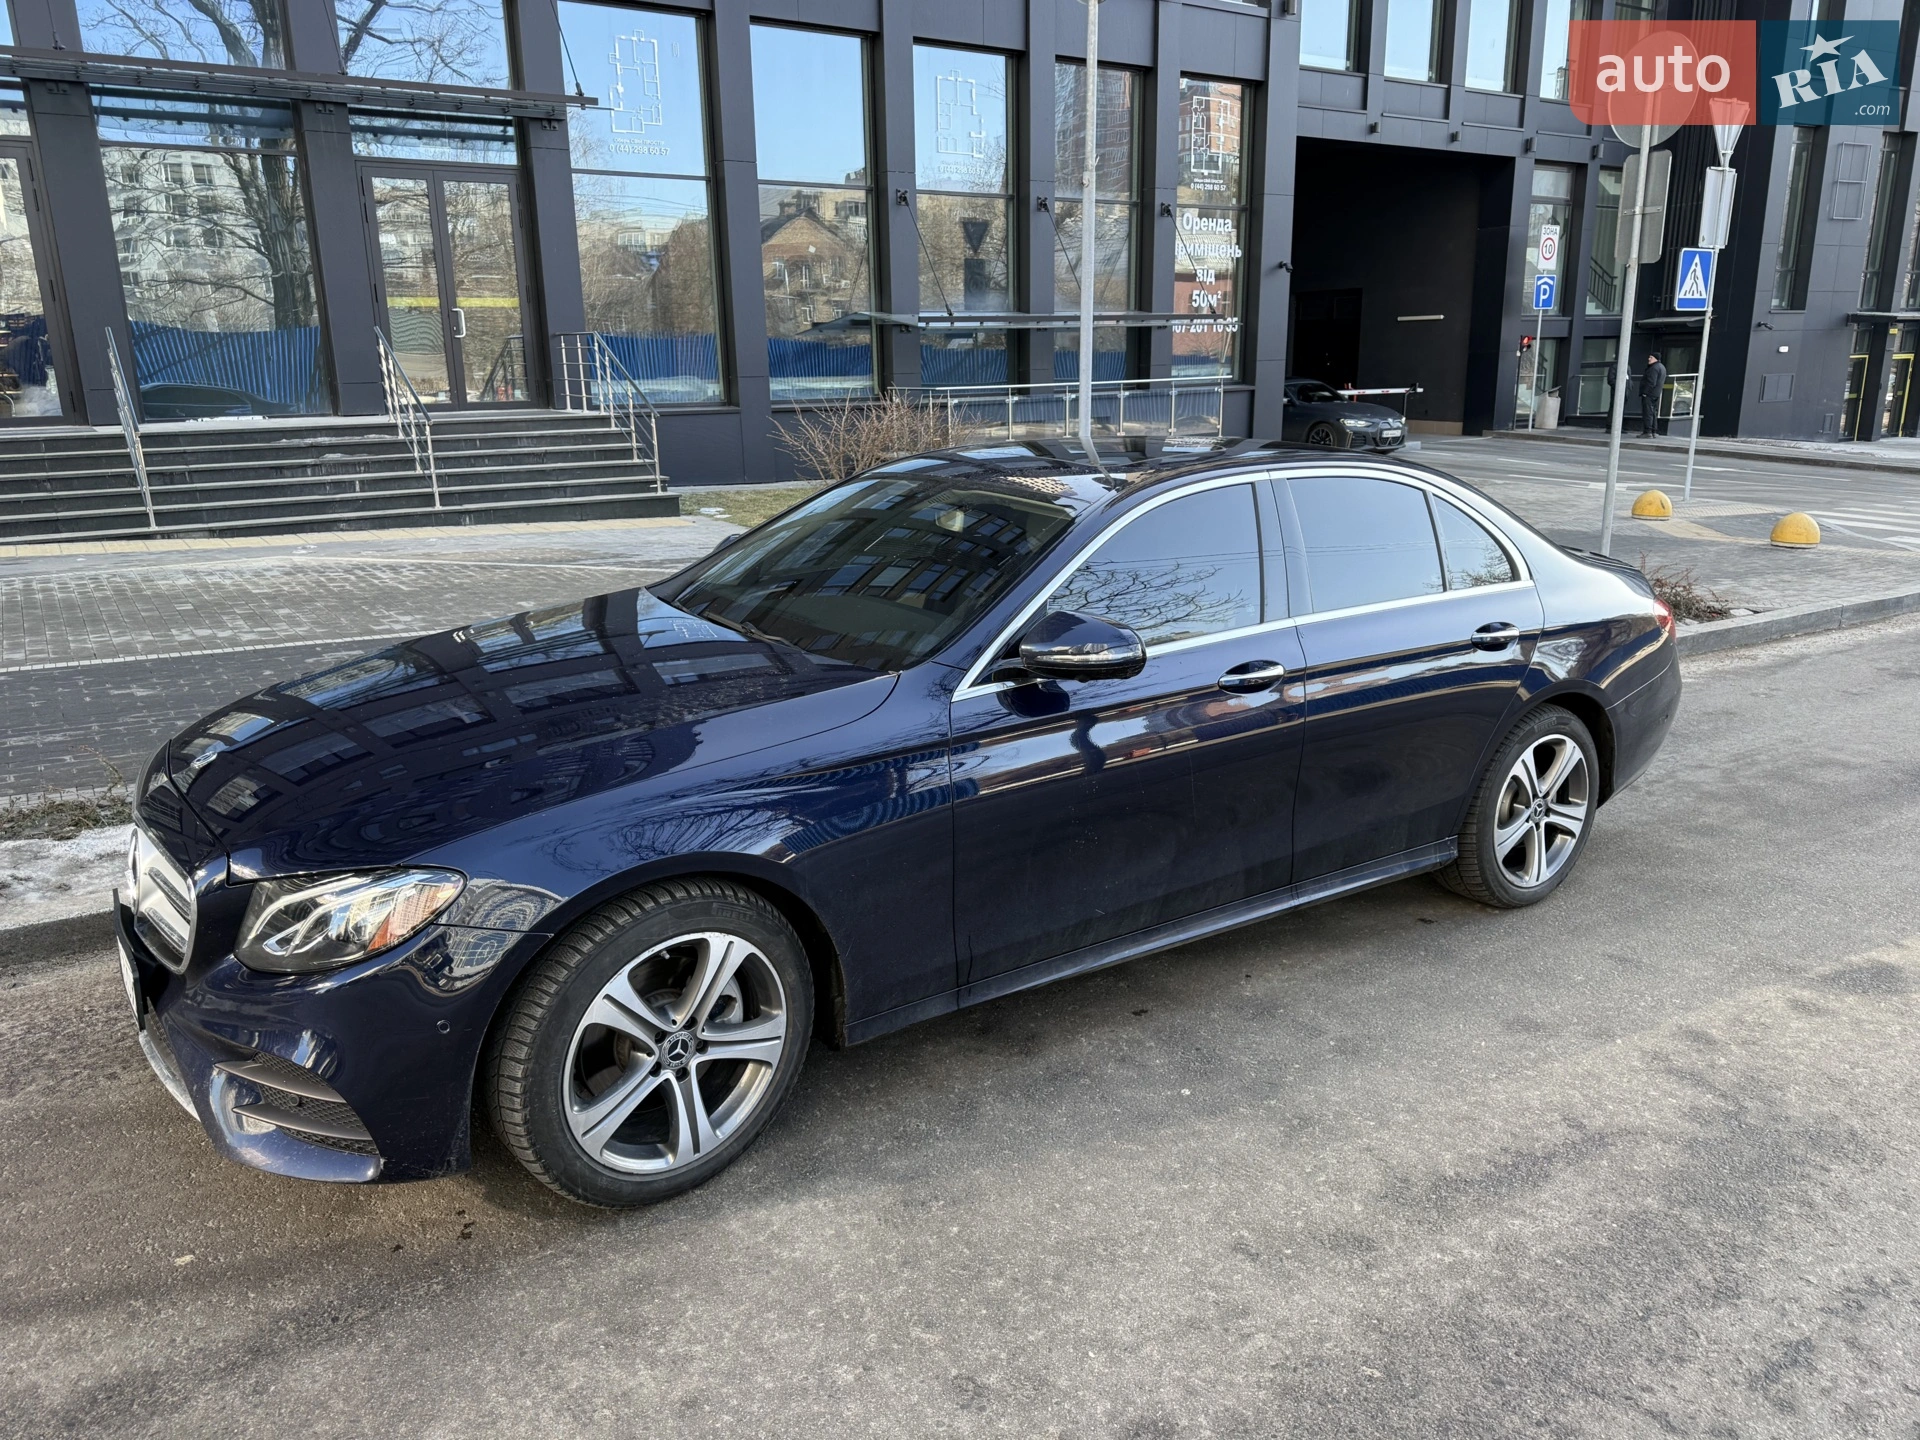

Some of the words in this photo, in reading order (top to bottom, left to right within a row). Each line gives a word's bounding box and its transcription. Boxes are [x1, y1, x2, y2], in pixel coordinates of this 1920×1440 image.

[609, 144, 615, 152] 0
[616, 145, 631, 154] (44)
[661, 148, 670, 156] 57
[1182, 213, 1233, 235] Оренда
[1542, 226, 1558, 236] ЗОНА
[1544, 244, 1553, 255] 10
[1195, 265, 1216, 286] від
[1539, 284, 1550, 307] P
